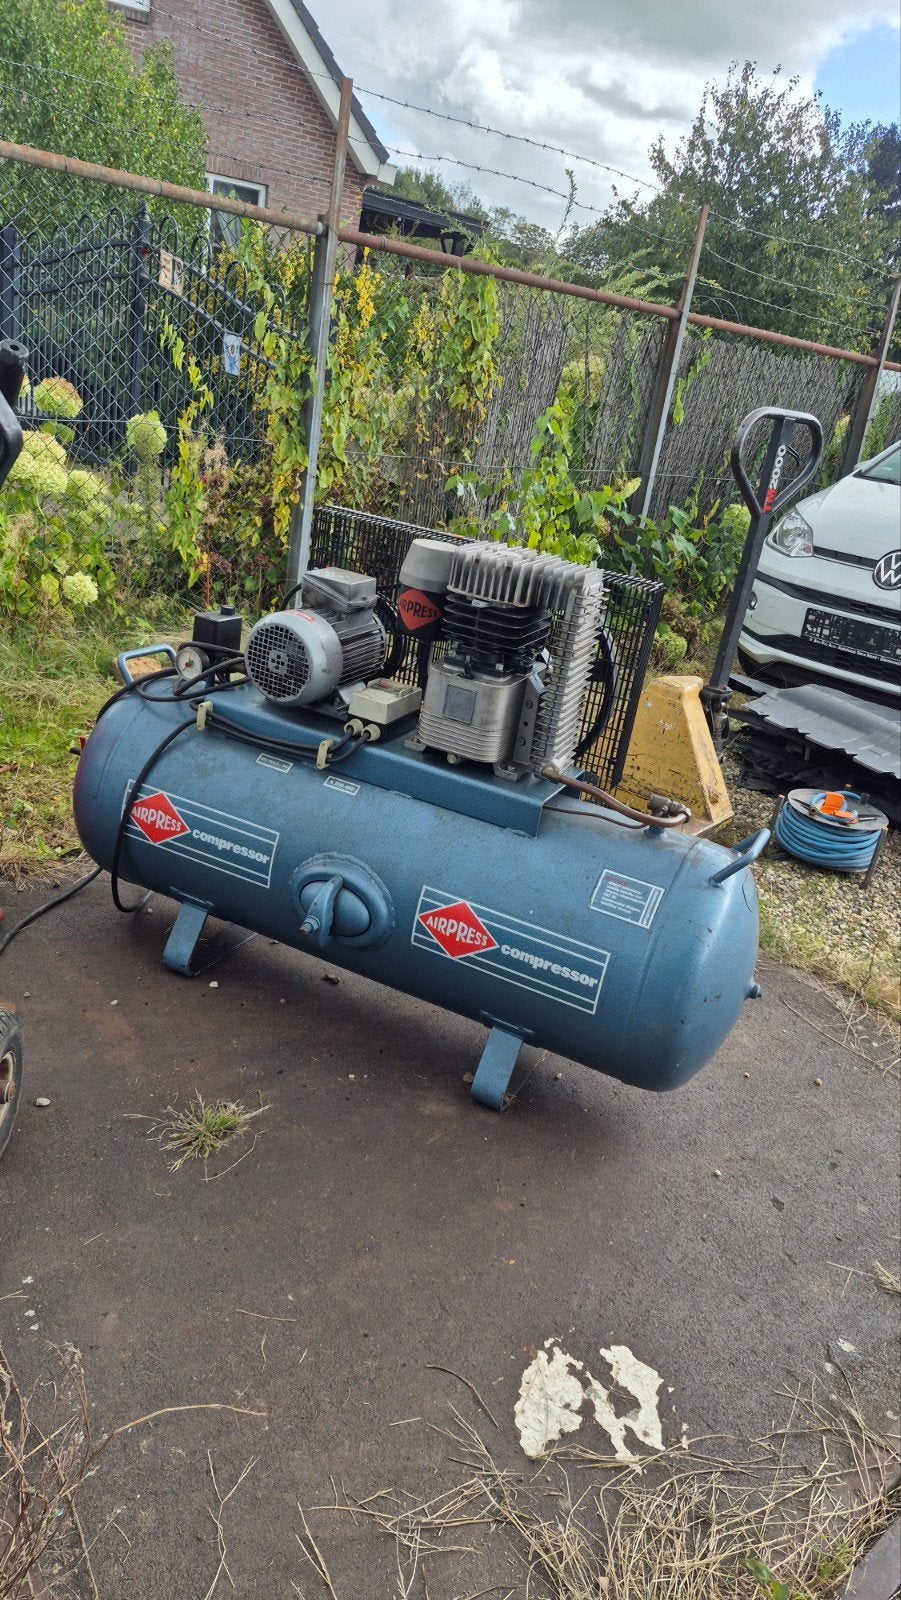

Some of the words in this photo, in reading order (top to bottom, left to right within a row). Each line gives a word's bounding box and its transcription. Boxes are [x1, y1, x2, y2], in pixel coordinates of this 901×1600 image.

[763, 445, 786, 513] TM2000
[132, 805, 182, 832] AIRPRESS
[192, 829, 270, 864] compressor
[426, 915, 488, 947] AIRPRESS
[501, 944, 599, 988] compressor
